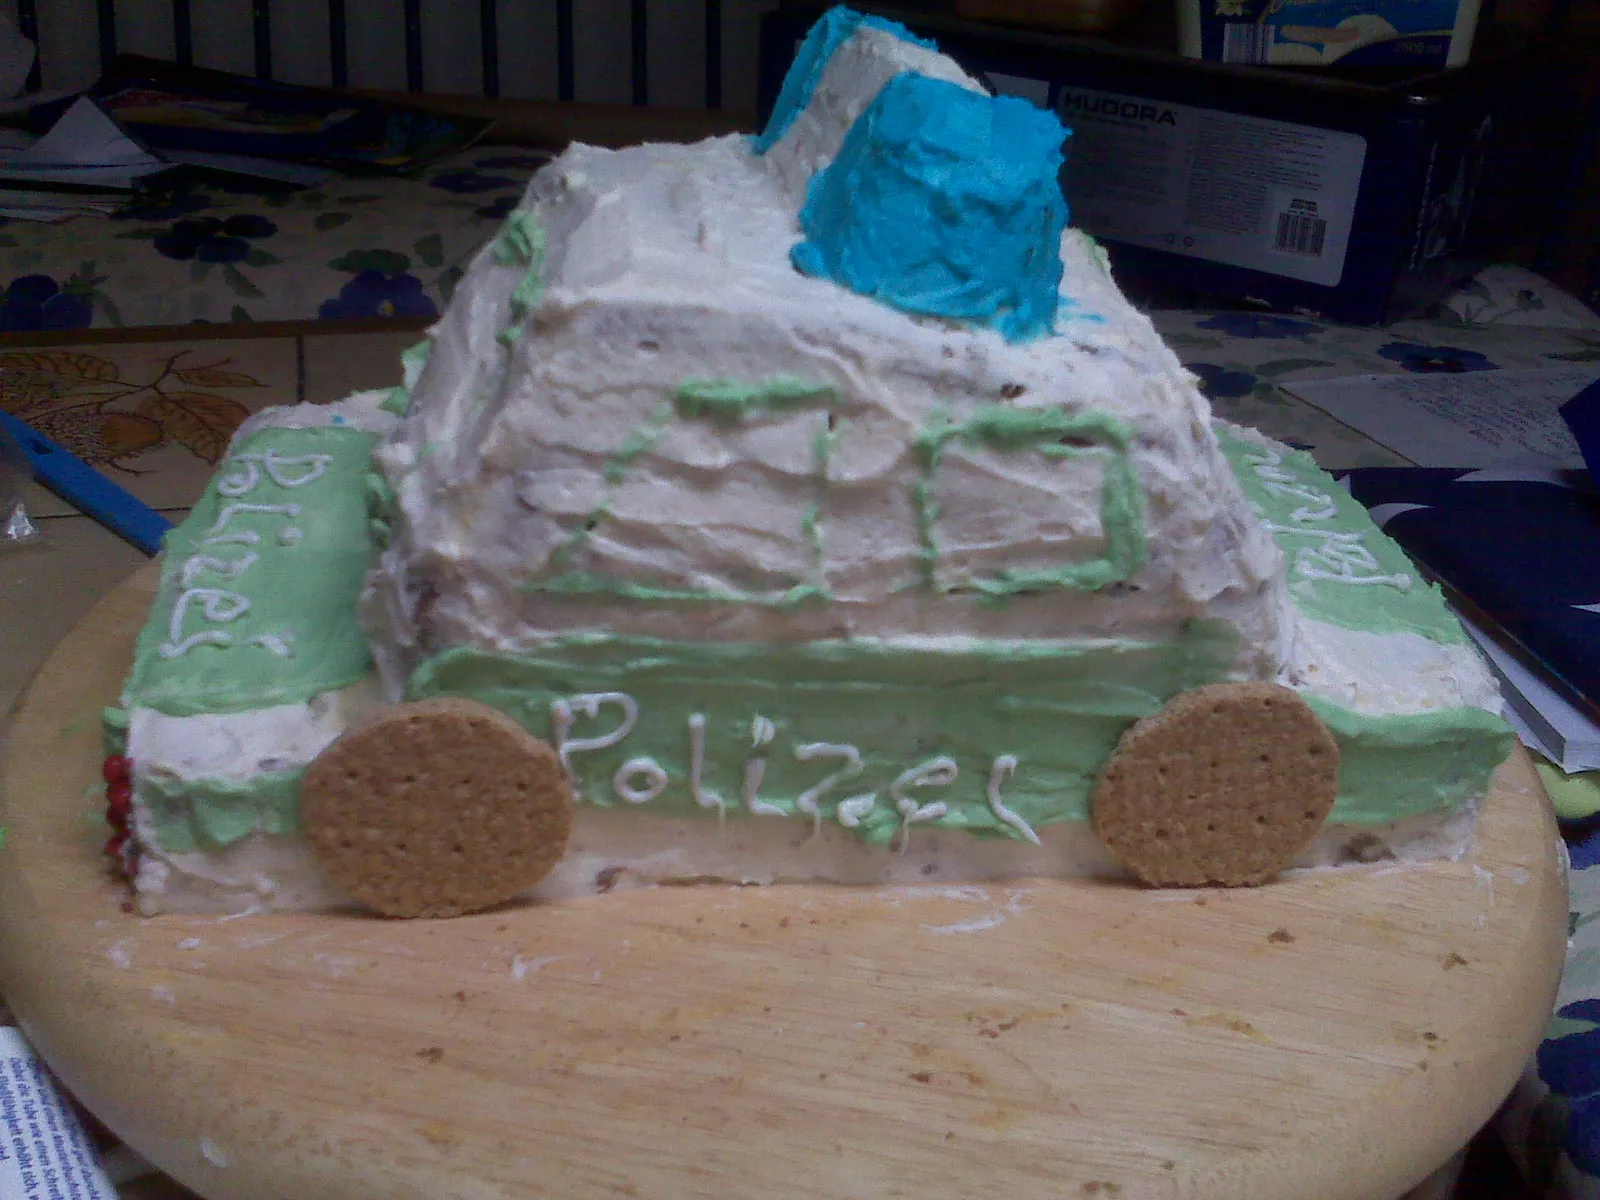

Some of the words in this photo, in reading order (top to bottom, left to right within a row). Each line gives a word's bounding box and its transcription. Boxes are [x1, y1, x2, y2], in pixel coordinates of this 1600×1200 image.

[1065, 92, 1176, 126] HUDORA
[160, 449, 333, 657] Polizei
[551, 691, 1041, 853] Polizei
